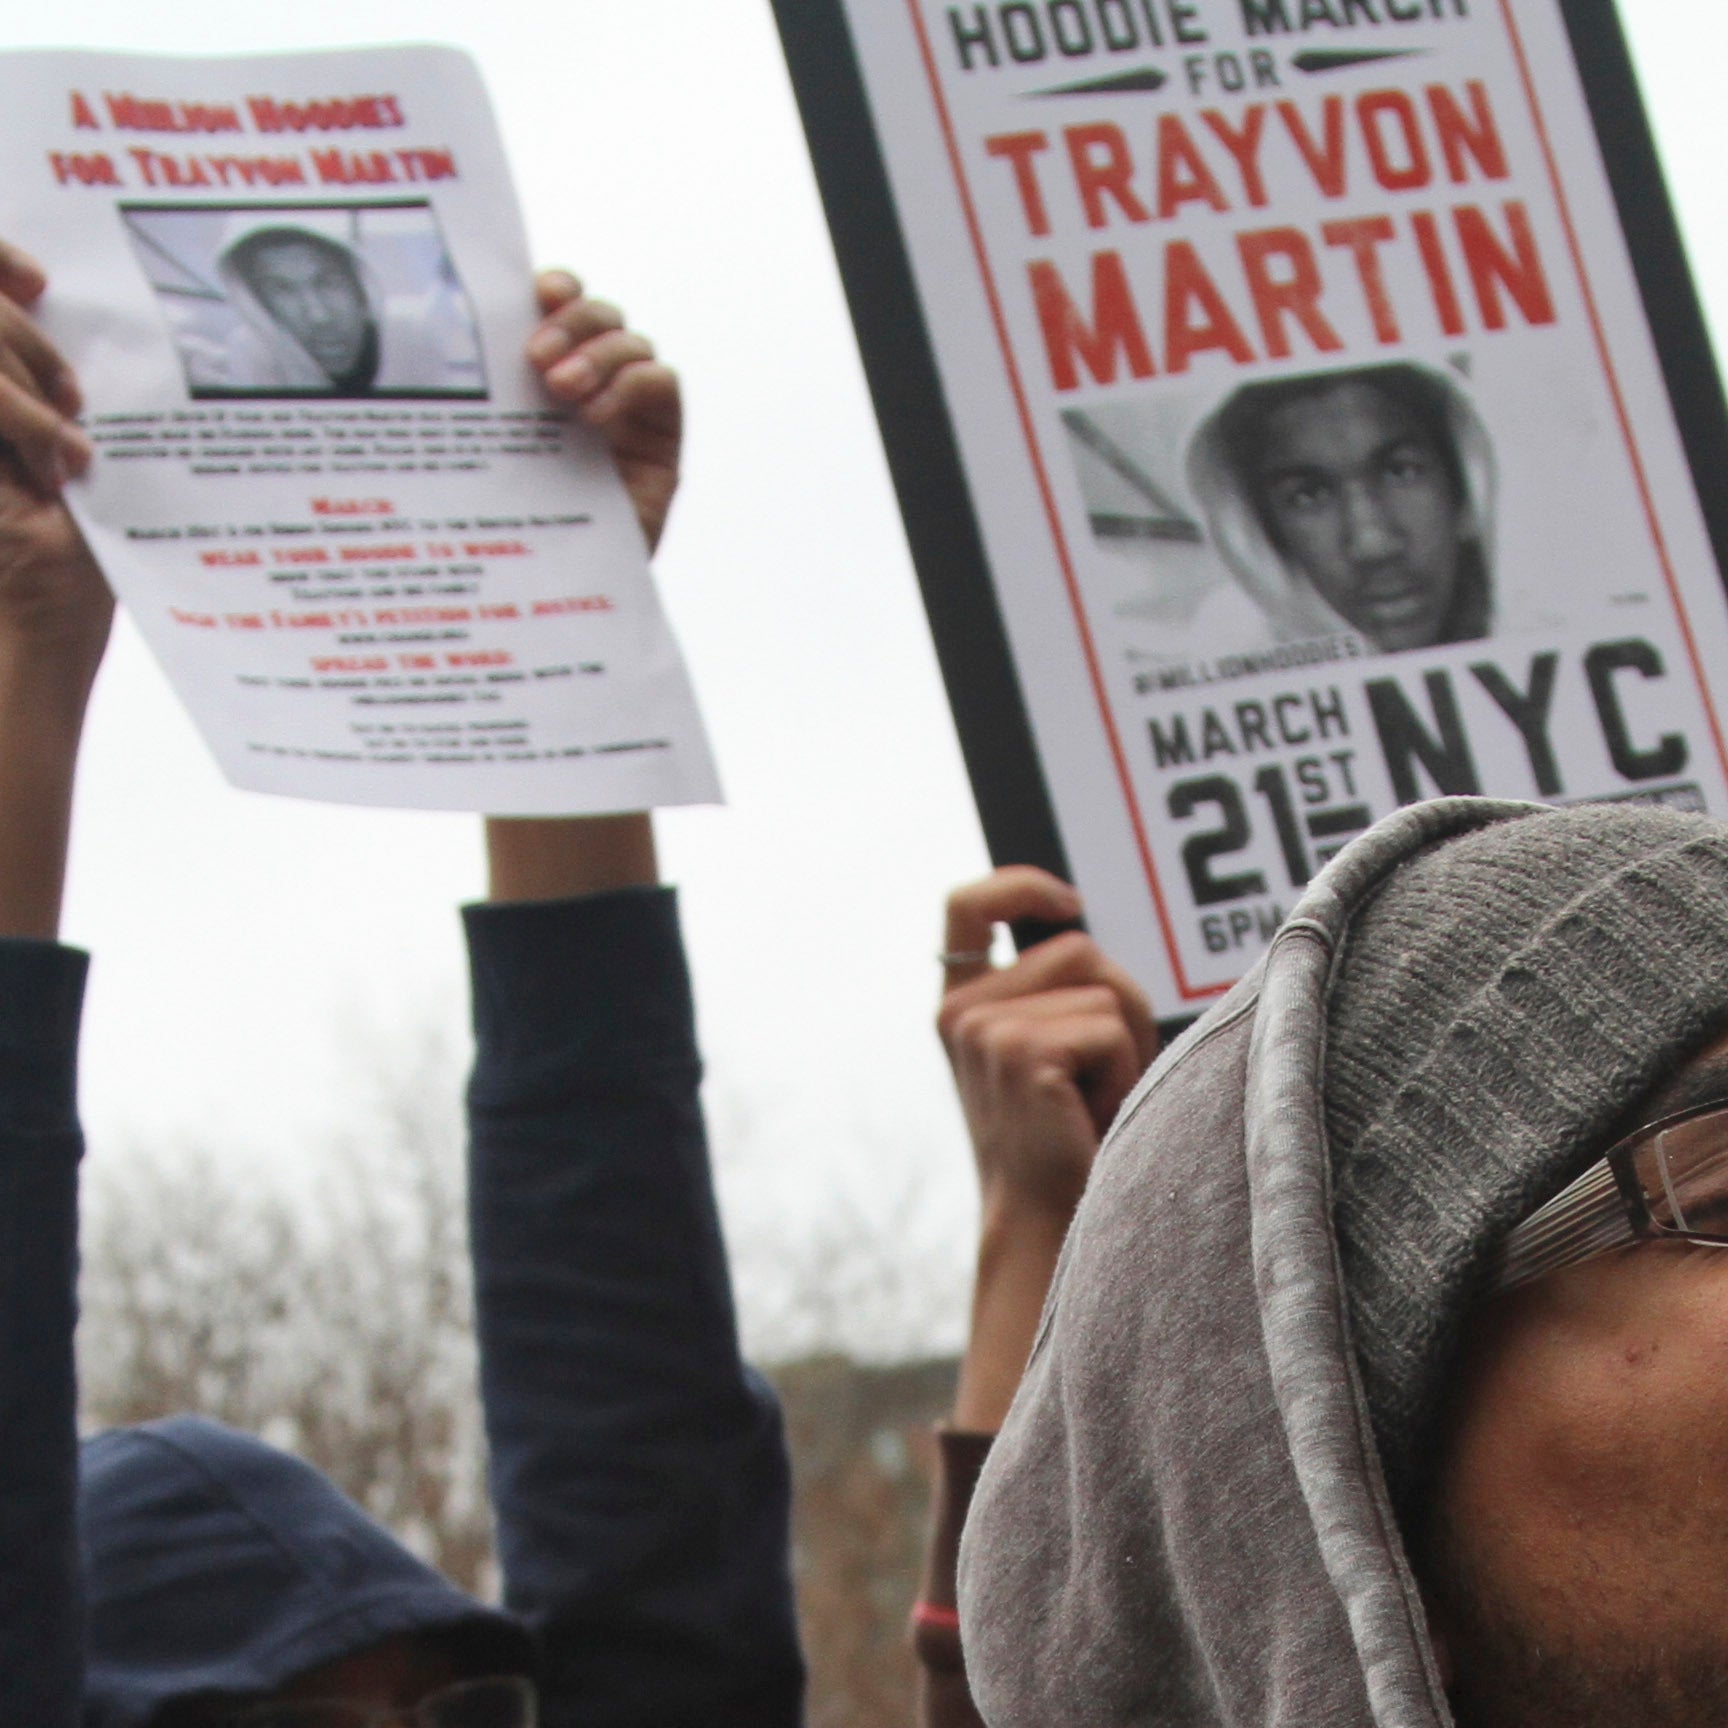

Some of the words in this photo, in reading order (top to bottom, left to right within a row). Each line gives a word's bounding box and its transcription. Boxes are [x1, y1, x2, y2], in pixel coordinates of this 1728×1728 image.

[948, 0, 1207, 70] HOODIE
[1183, 50, 1282, 96] FOR
[69, 89, 99, 131] A
[47, 150, 123, 186] FOR
[126, 145, 308, 187] TRAYVON
[309, 145, 458, 184] MARTIN
[986, 79, 1510, 238] TRAYVON
[1025, 199, 1556, 393] MARTIN
[1147, 686, 1352, 769] MARCH
[1364, 636, 1689, 805] NYC
